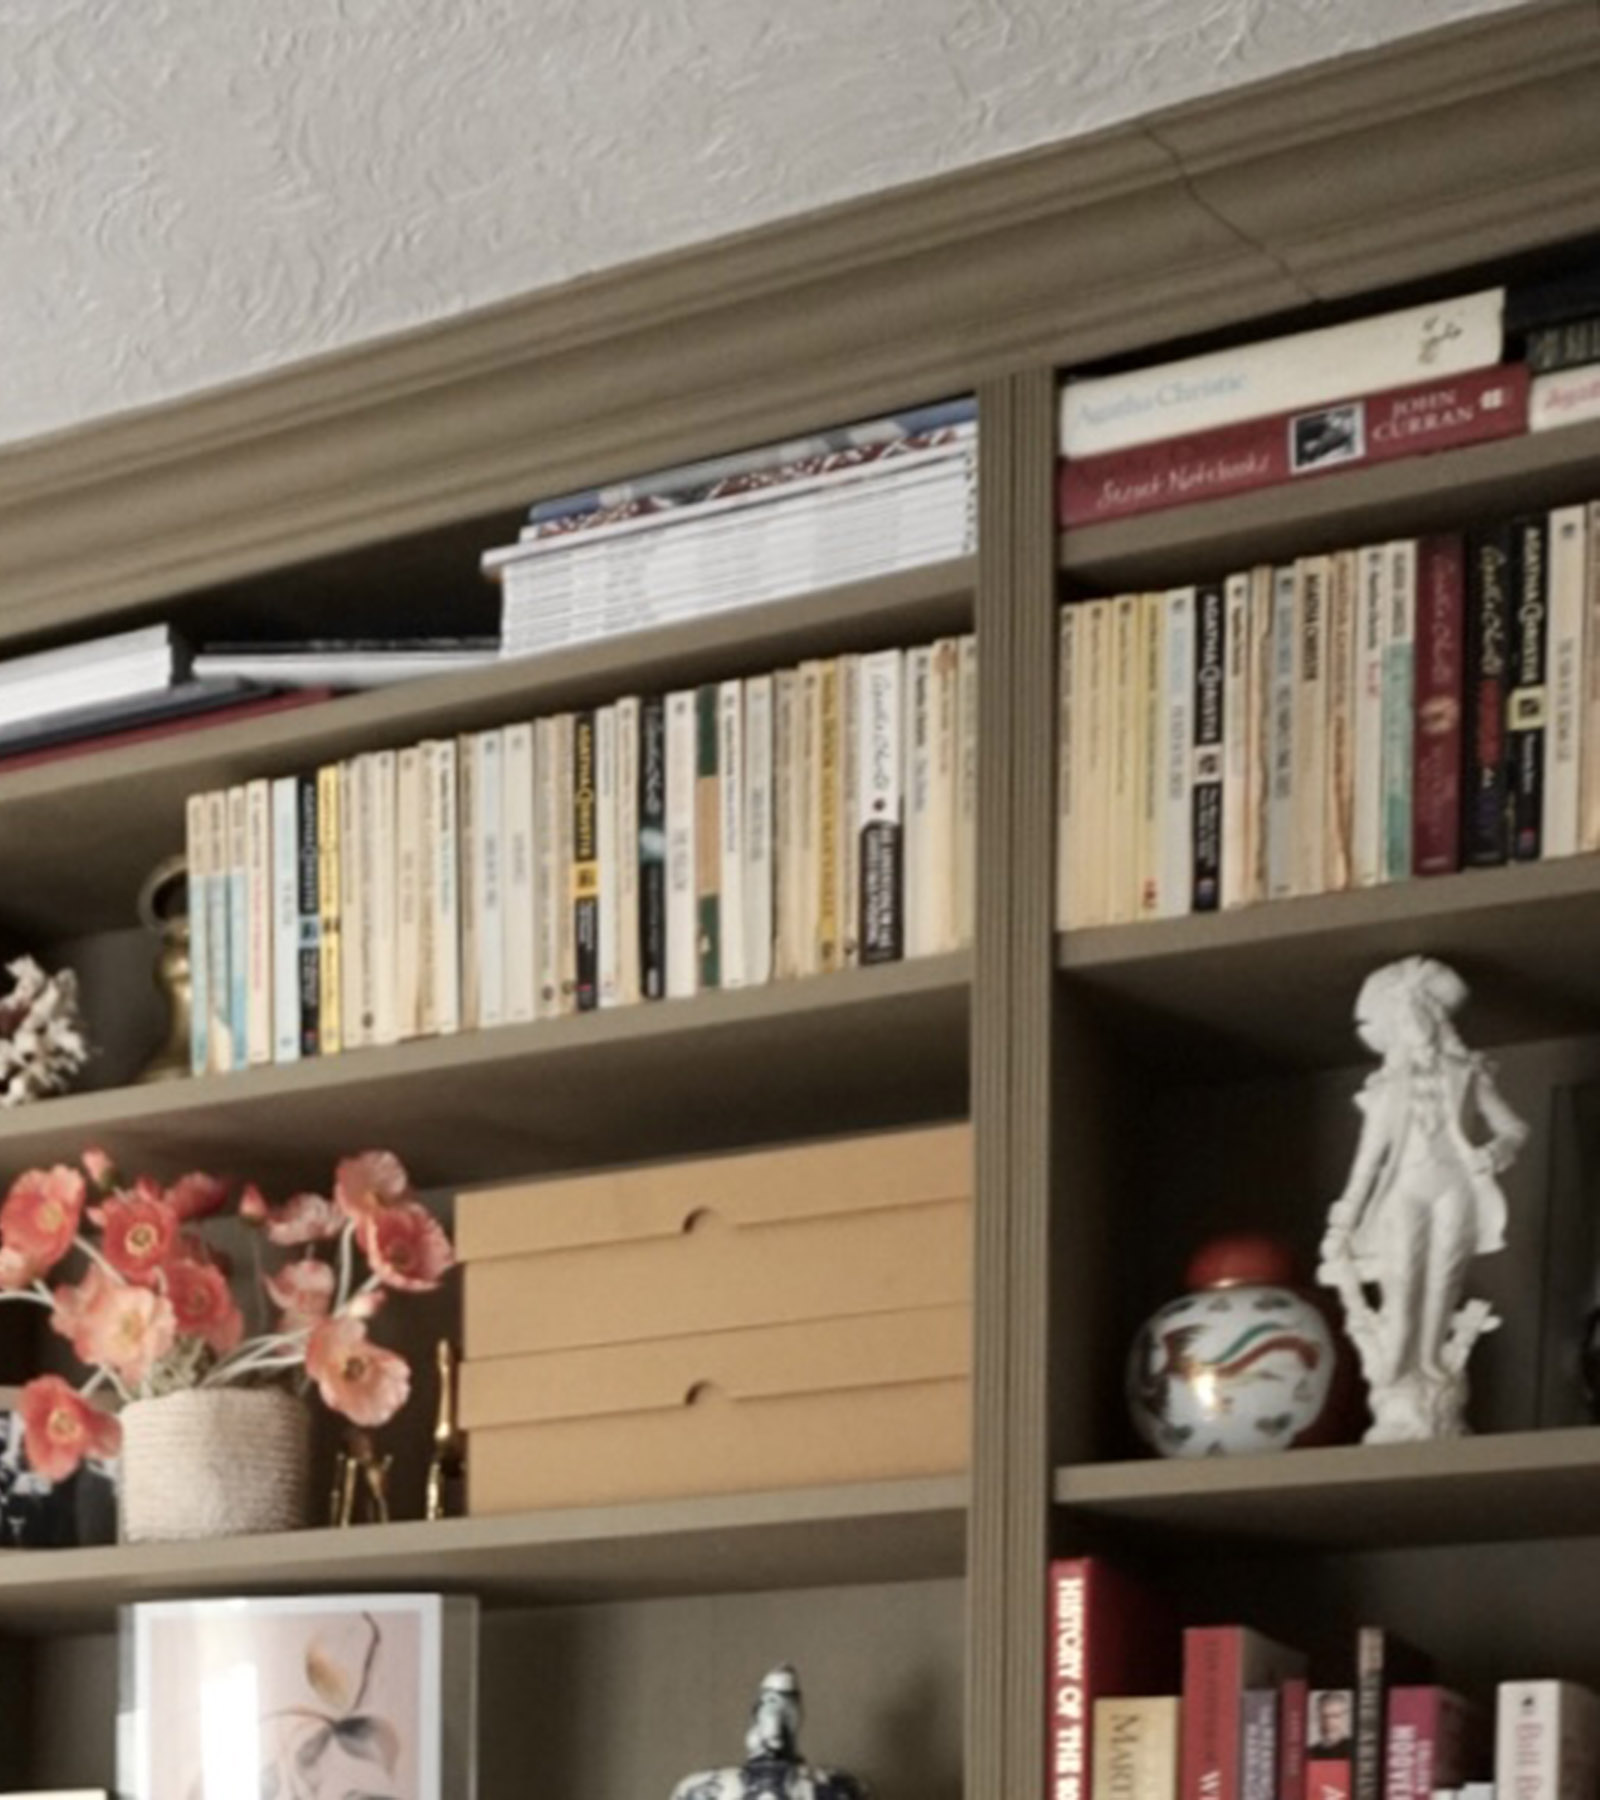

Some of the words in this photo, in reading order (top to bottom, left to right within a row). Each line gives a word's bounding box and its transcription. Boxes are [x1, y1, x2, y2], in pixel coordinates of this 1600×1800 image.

[1078, 390, 1153, 425] Agatha
[1156, 372, 1247, 406] Christie
[1371, 406, 1474, 442] CURRAN
[1390, 389, 1457, 418] JOHN
[1522, 526, 1543, 600] AGATHA
[1303, 574, 1319, 624] AGATHA
[1202, 594, 1218, 664] AGATHA
[1303, 626, 1319, 682] CHRISTIE
[1518, 599, 1544, 683] CHRISTIE
[1199, 663, 1222, 741] CHRISTIE
[580, 722, 592, 785] AGATHA
[576, 785, 594, 858] CHRISTIE
[1057, 1577, 1084, 1680] HISTORY
[1056, 1685, 1082, 1720] OF
[1056, 1725, 1081, 1774] THE
[1111, 1714, 1140, 1800] MART
[1515, 1722, 1544, 1767] Bill
